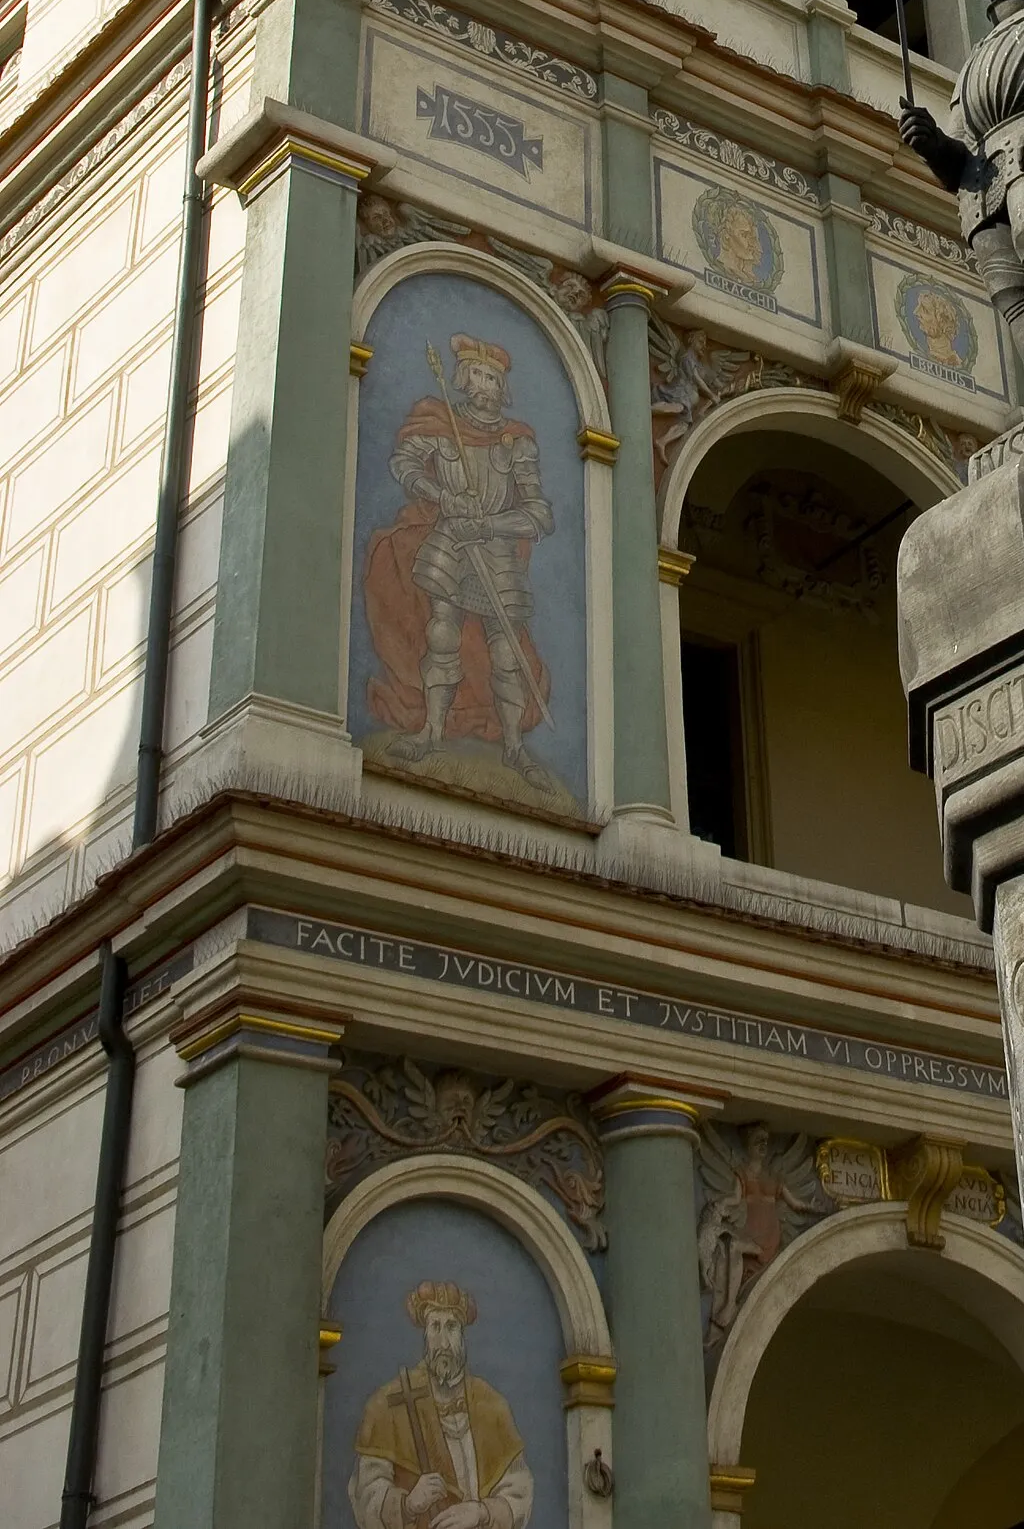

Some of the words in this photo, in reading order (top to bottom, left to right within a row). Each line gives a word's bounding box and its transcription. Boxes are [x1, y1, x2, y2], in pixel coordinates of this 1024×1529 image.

[440, 93, 518, 158] 1555
[710, 273, 771, 311] GRACCHI
[918, 357, 966, 388] BRUTUS
[295, 920, 417, 971] FACITE
[438, 952, 577, 1005] JVDICIVM
[598, 989, 639, 1018] ET
[659, 1002, 809, 1056] JVSTITIAM
[823, 1036, 851, 1064] VI
[864, 1045, 1006, 1097] OPPRESSVM
